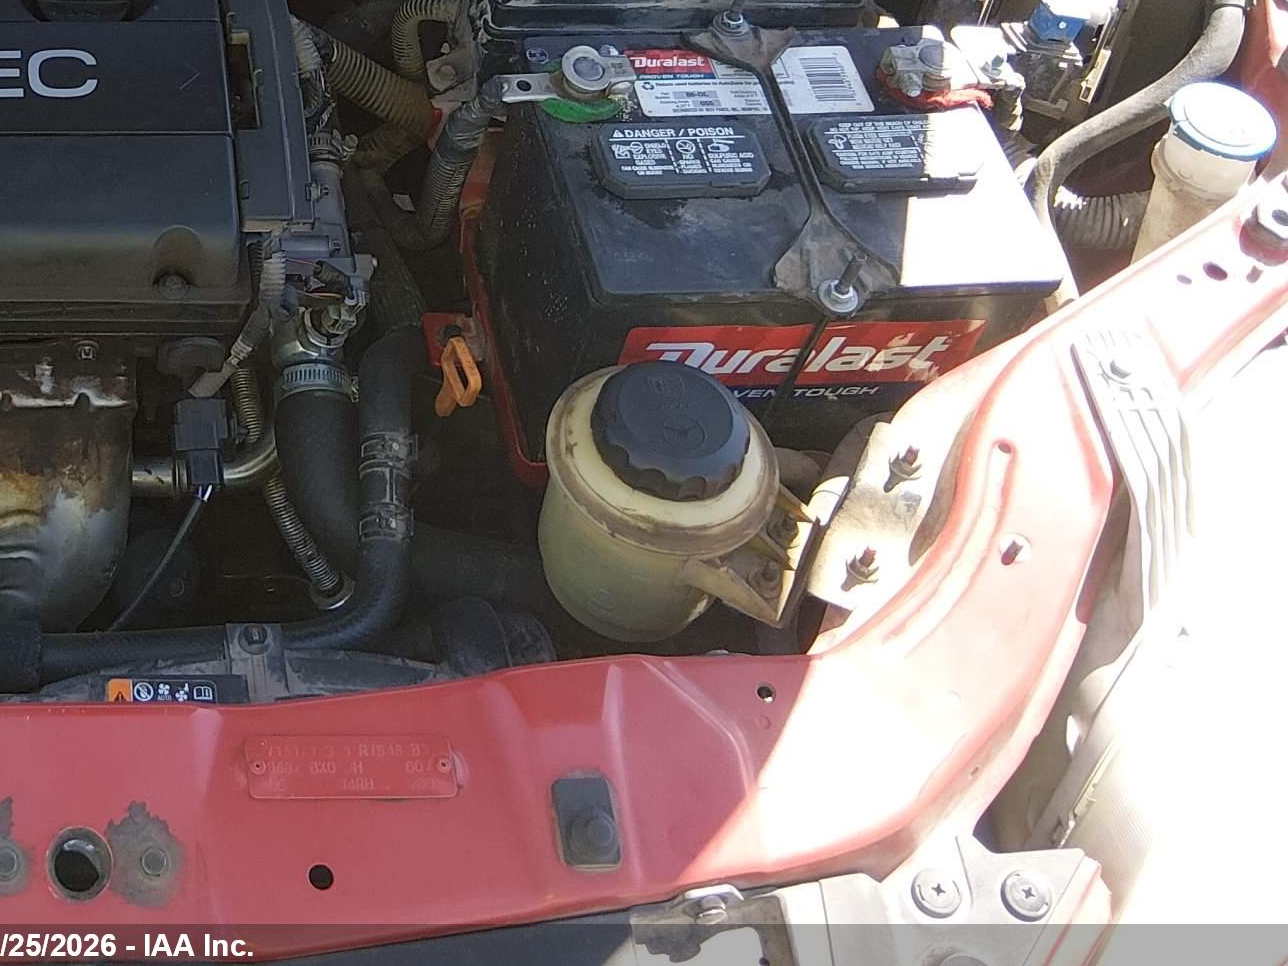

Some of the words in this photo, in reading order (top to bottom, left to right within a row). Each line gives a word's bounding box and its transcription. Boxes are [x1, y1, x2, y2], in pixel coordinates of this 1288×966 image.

[629, 55, 705, 68] Duralast
[623, 129, 676, 138] DANGER
[687, 127, 734, 136] POISON
[646, 336, 952, 375] Duralast
[793, 386, 880, 397] TOUGH
